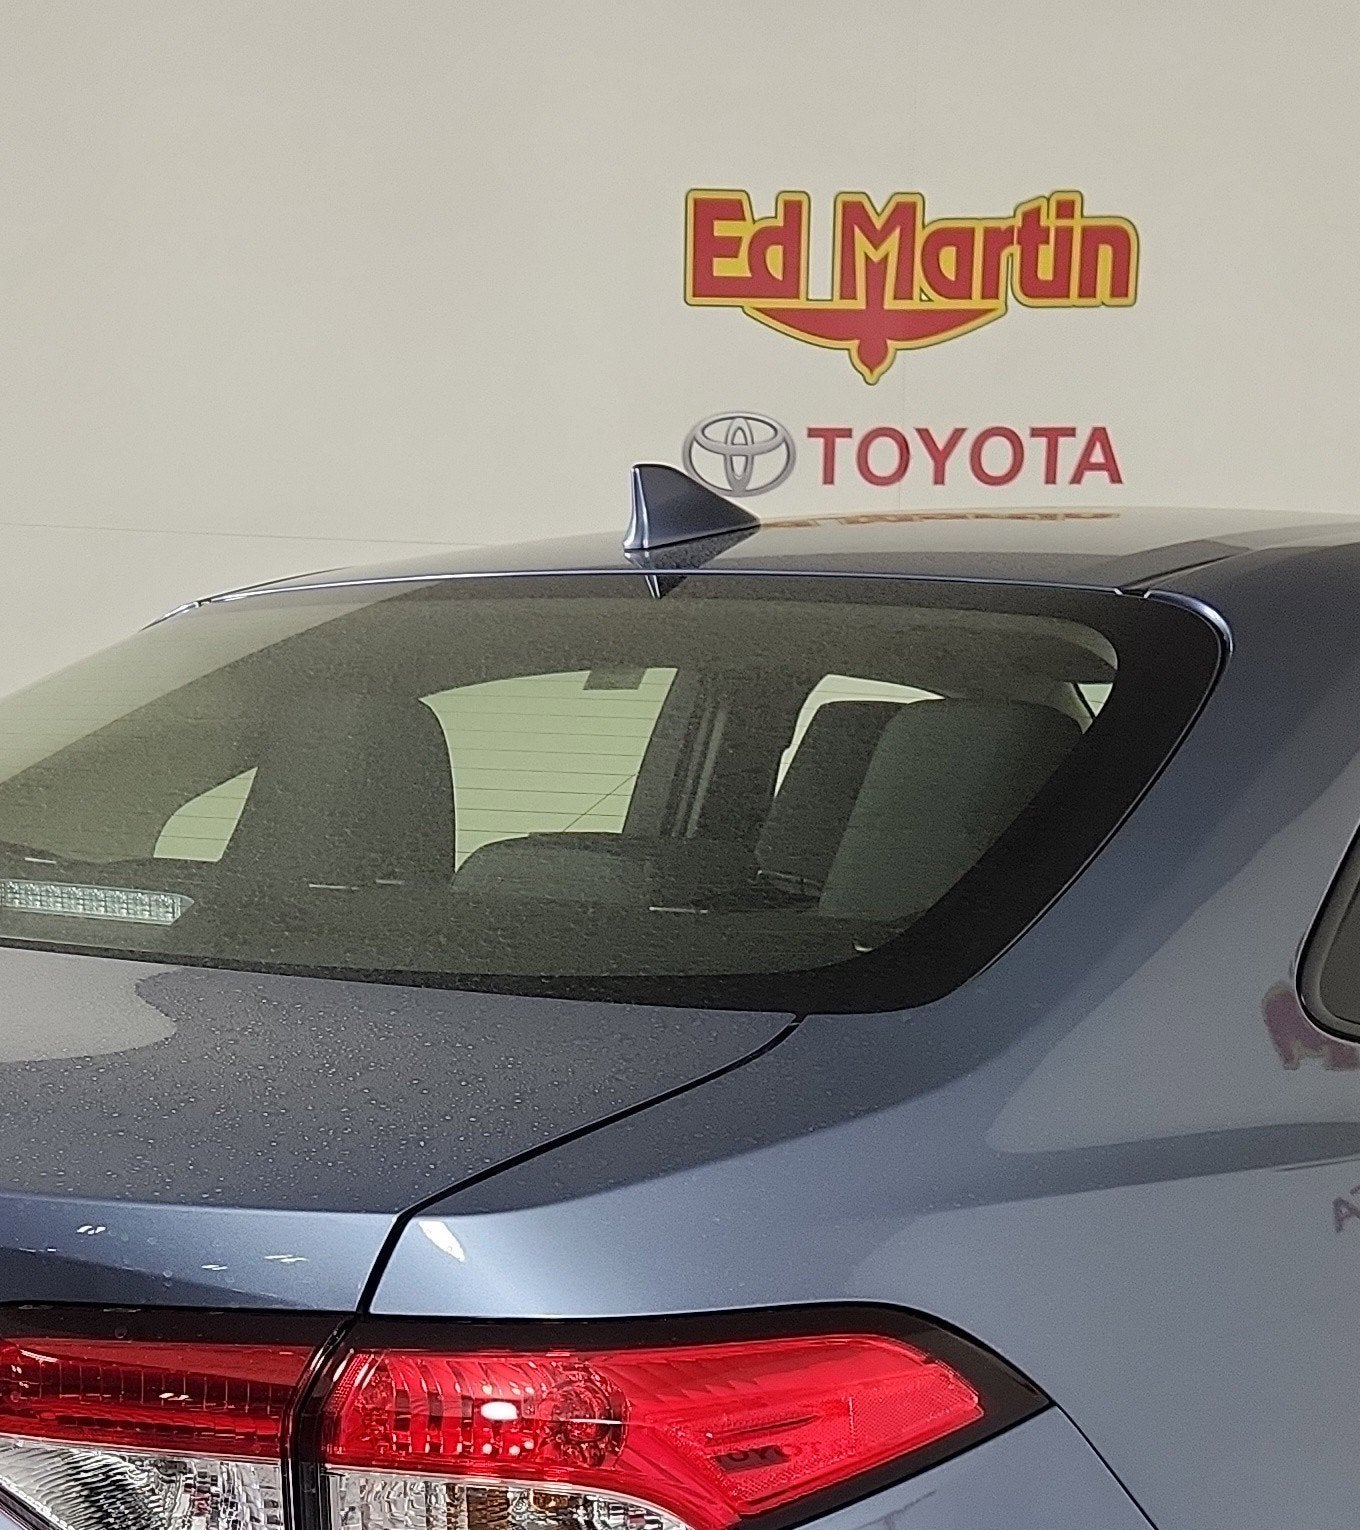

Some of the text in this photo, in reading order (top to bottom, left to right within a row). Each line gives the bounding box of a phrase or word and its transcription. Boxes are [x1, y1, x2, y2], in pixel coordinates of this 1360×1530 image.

[687, 190, 1139, 306] Ed Martin
[807, 426, 1123, 486] TOYOTA
